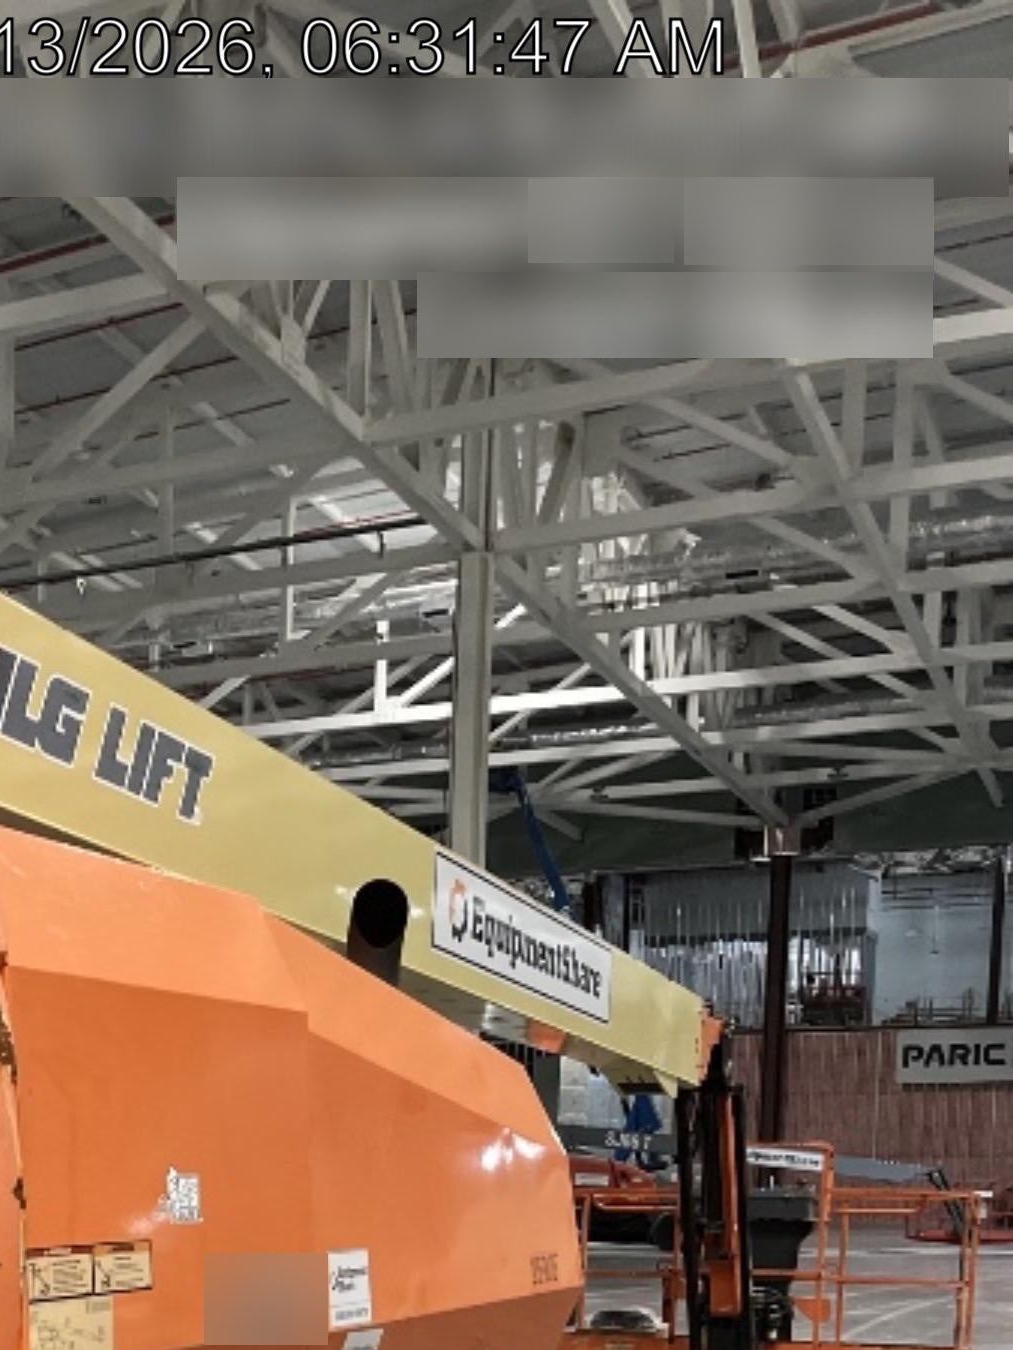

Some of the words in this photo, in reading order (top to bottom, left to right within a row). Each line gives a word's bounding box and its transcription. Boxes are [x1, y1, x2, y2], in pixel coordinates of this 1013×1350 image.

[93, 702, 214, 825] LIFT
[472, 896, 601, 999] EquipmentShare
[902, 1043, 1006, 1069] PARIC
